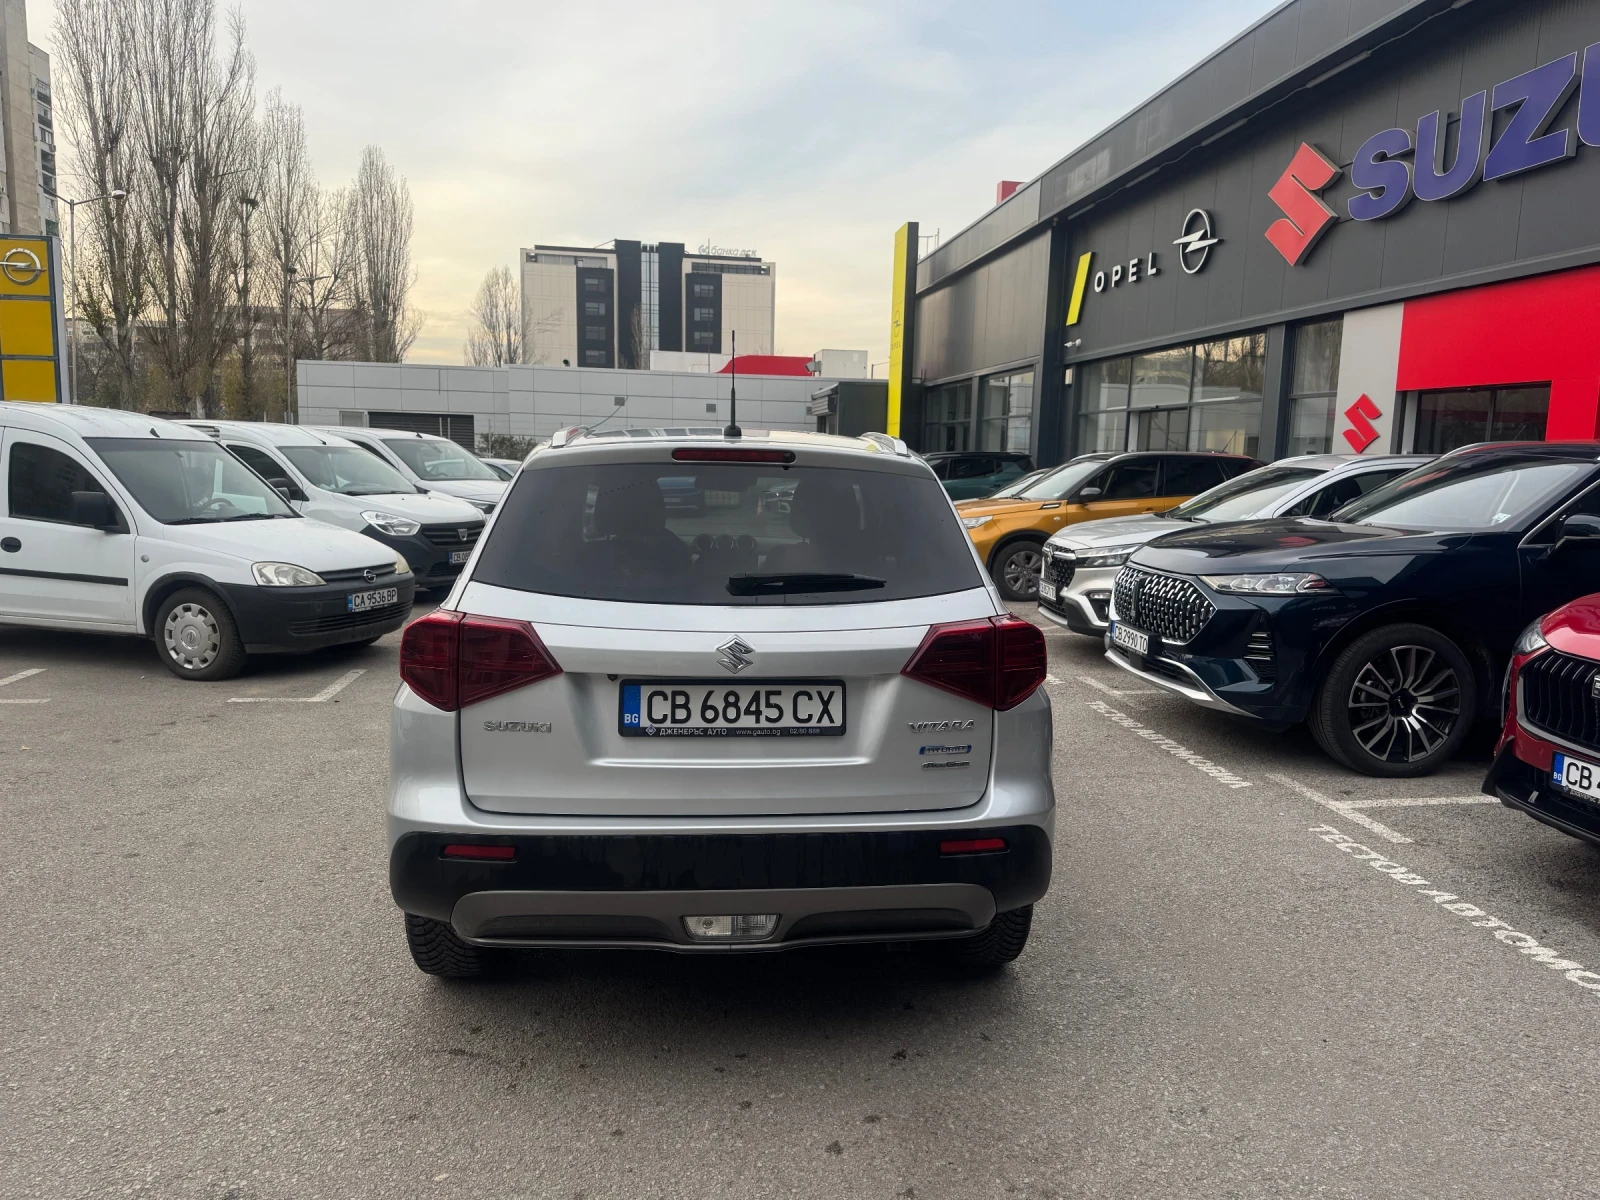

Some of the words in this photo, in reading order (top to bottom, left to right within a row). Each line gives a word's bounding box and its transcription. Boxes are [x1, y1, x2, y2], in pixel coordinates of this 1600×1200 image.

[1094, 252, 1157, 293] OPEL
[354, 594, 366, 607] CA
[367, 591, 386, 606] 9536
[387, 589, 397, 602] BP
[1123, 629, 1138, 647] 2990
[647, 690, 692, 724] CB
[700, 690, 784, 724] 6845
[792, 690, 836, 724] CX
[483, 720, 552, 733] SUZUKI
[624, 713, 639, 724] BG
[908, 719, 975, 733] VITARA
[659, 728, 704, 736] ДЖЕНЕРЪС
[707, 728, 728, 736] АУТО
[735, 728, 781, 737] www.gauto.bg
[925, 746, 966, 754] HYBRID
[1553, 771, 1562, 781] BG
[1565, 761, 1592, 790] CB
[1308, 824, 1431, 885] ТЕСТОВ
[1417, 889, 1600, 998] АВТОМО
